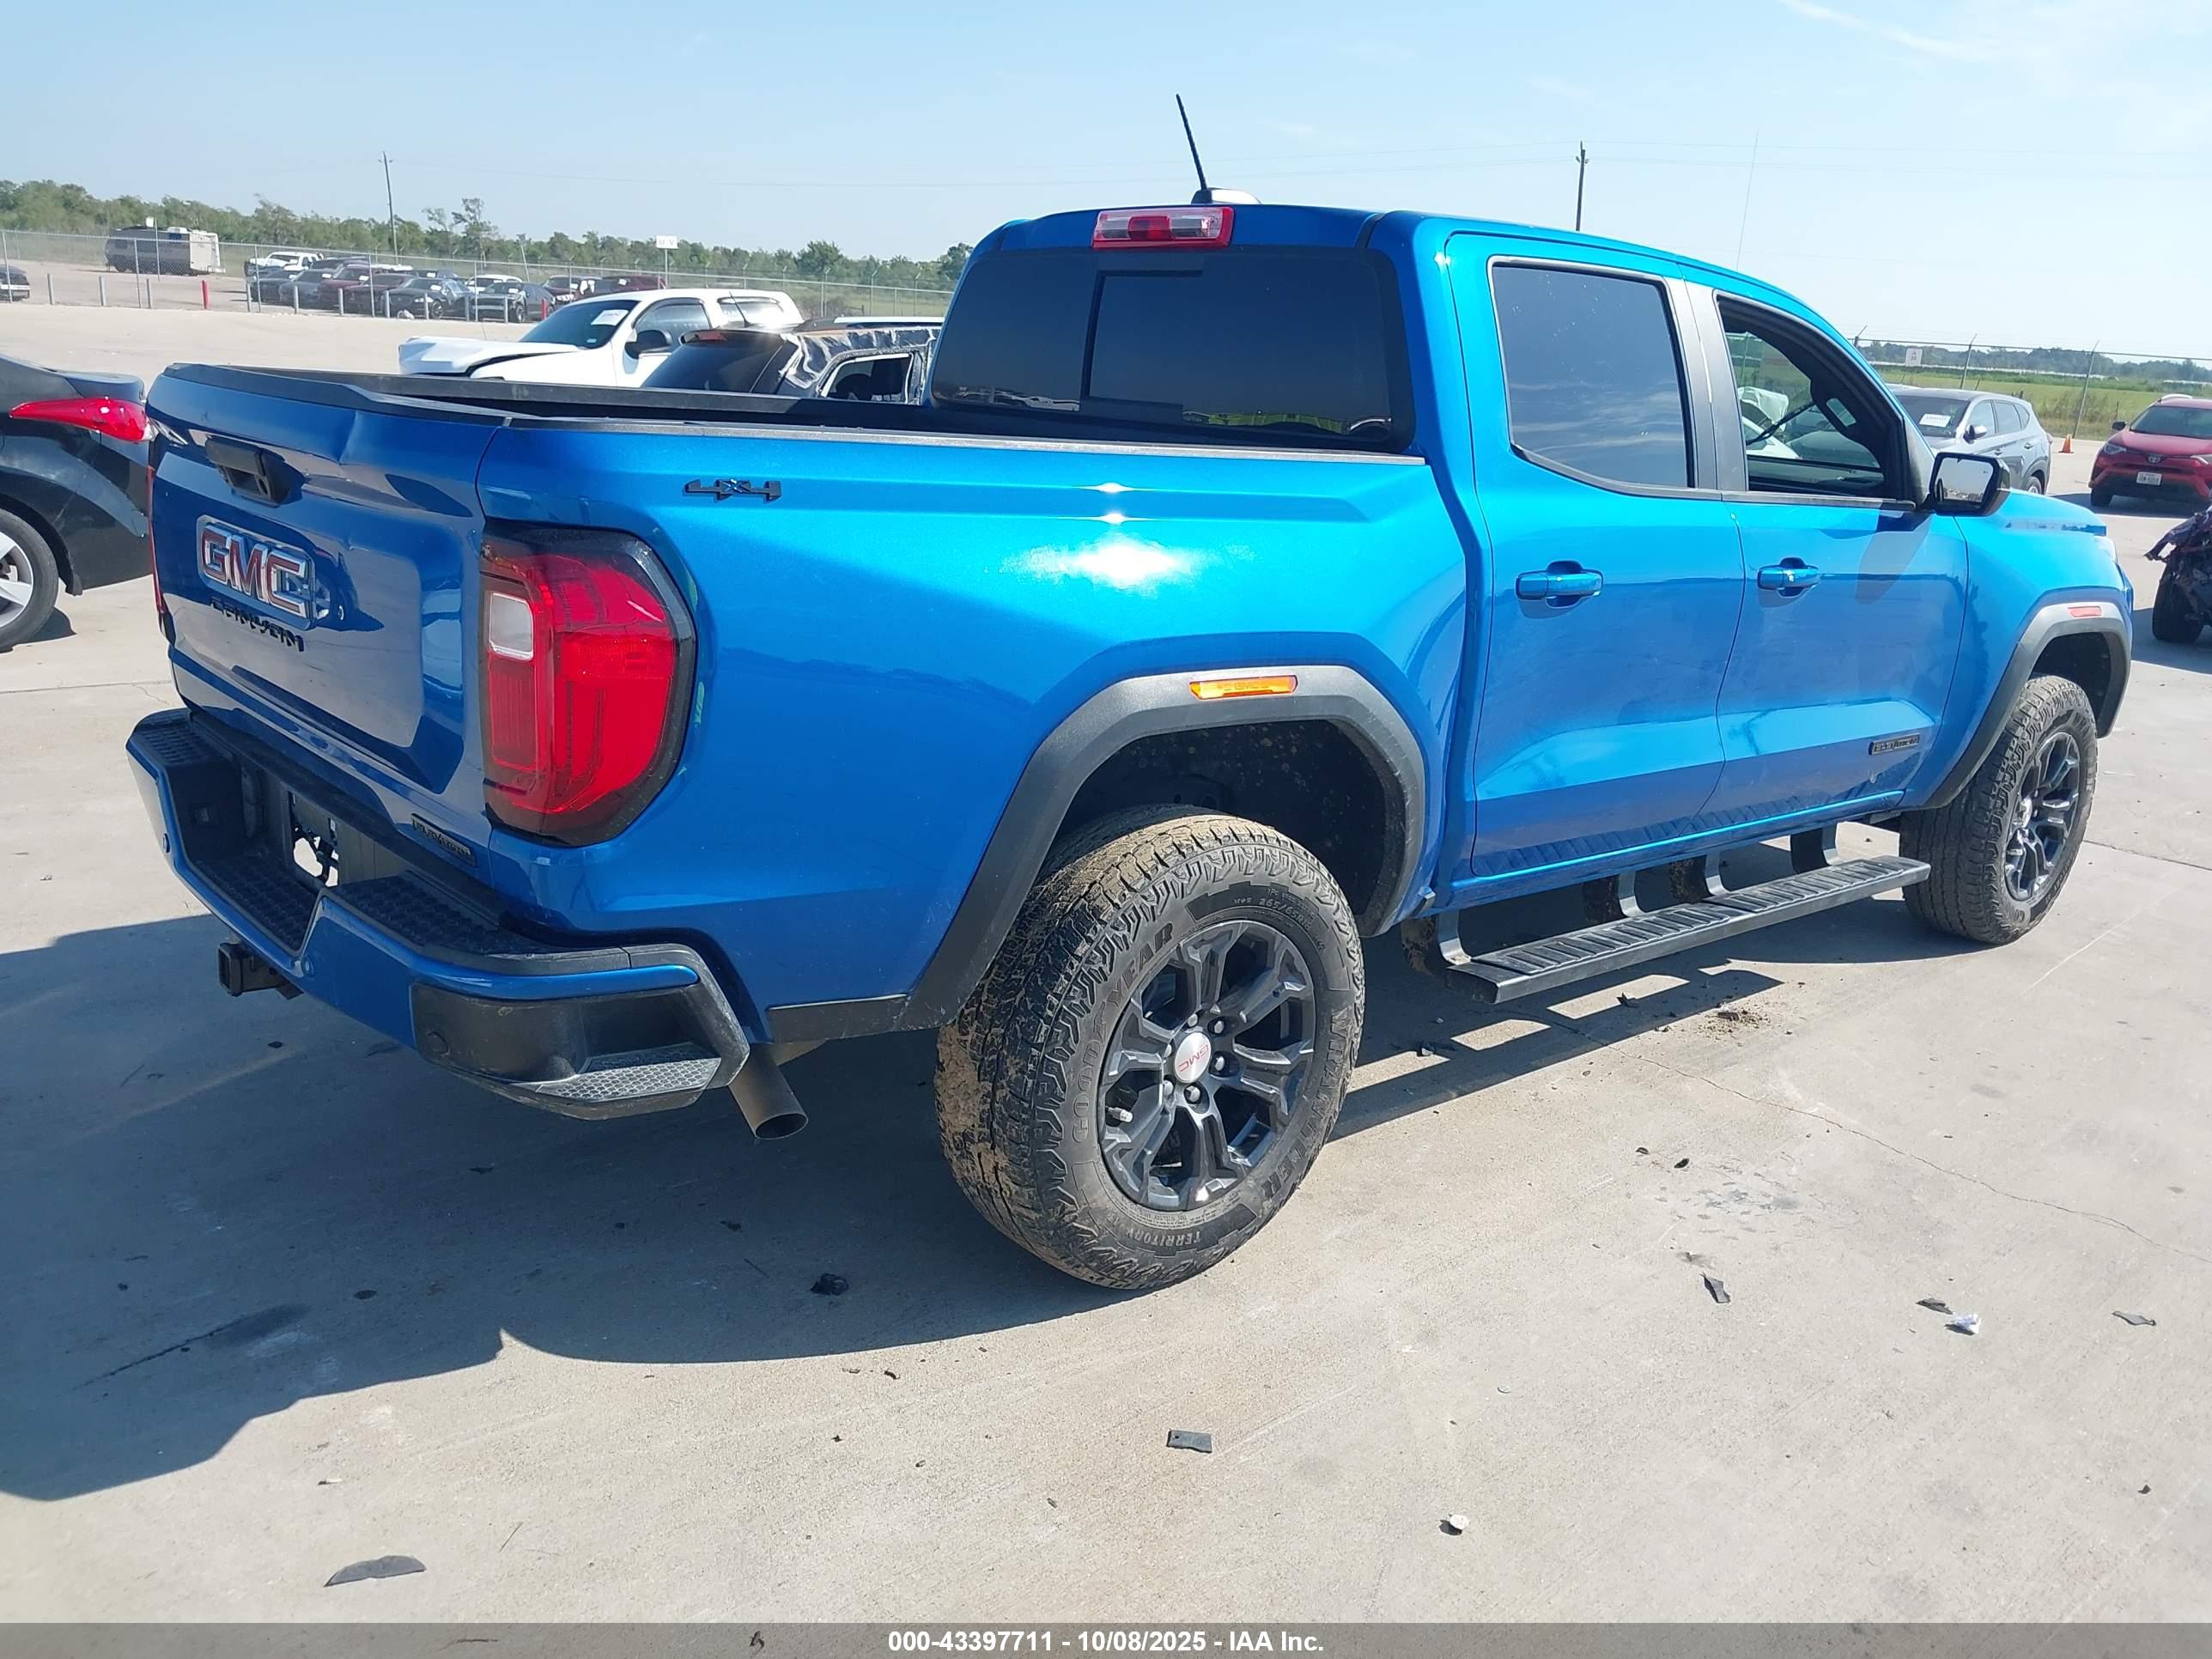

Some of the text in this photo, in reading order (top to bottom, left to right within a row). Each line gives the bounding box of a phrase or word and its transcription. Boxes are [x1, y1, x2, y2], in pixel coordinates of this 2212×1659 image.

[201, 523, 314, 620] GMC
[1073, 922, 1175, 1144] GOODYEAR
[1178, 1043, 1209, 1073] GMC
[1261, 1006, 1353, 1200] WRANGLER
[1126, 1229, 1202, 1248] TERRITORY
